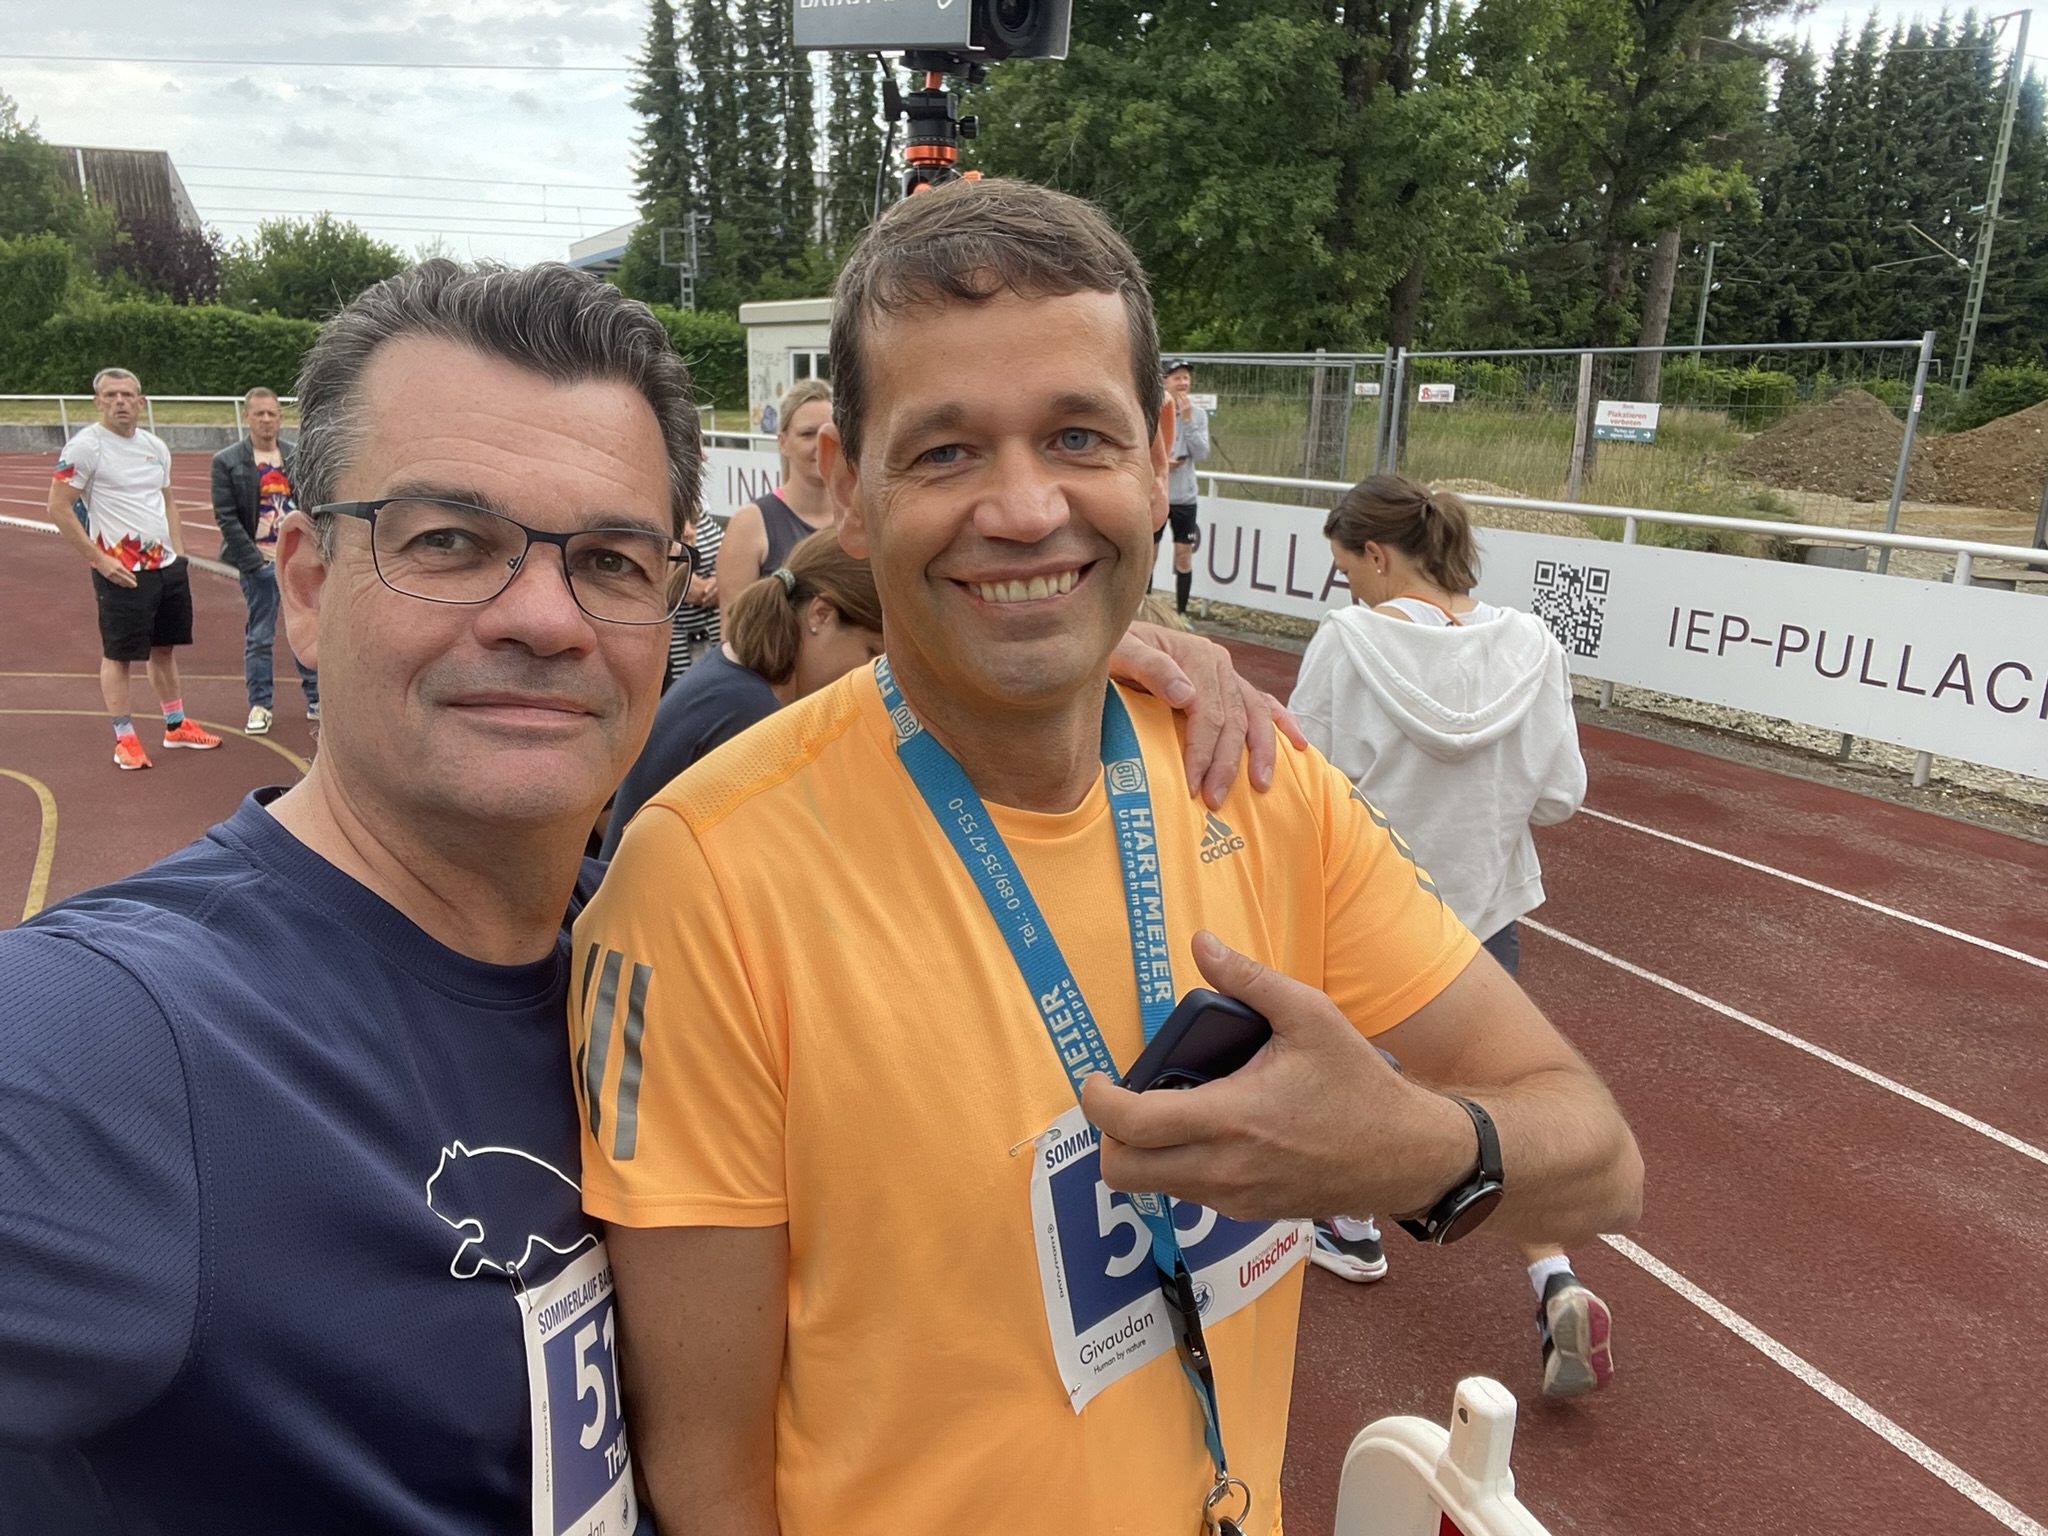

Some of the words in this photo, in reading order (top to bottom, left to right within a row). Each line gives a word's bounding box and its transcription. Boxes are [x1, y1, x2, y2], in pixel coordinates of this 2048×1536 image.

[1607, 410, 1647, 420] Plakatieren
[948, 798, 979, 835] 53-0
[969, 836, 988, 853] 47
[982, 854, 1021, 910] 089/35
[1118, 809, 1153, 1004] Unternehmensgruppe
[1130, 808, 1172, 1003] HARTMEIER
[1040, 984, 1095, 1094] MEIER
[1239, 1228, 1299, 1289] Umschau
[537, 1276, 598, 1336] SOMMERLAUF
[1080, 1313, 1154, 1365] Givaudan
[1093, 1356, 1116, 1375] Human
[1116, 1351, 1125, 1361] by
[1126, 1339, 1147, 1355] nature
